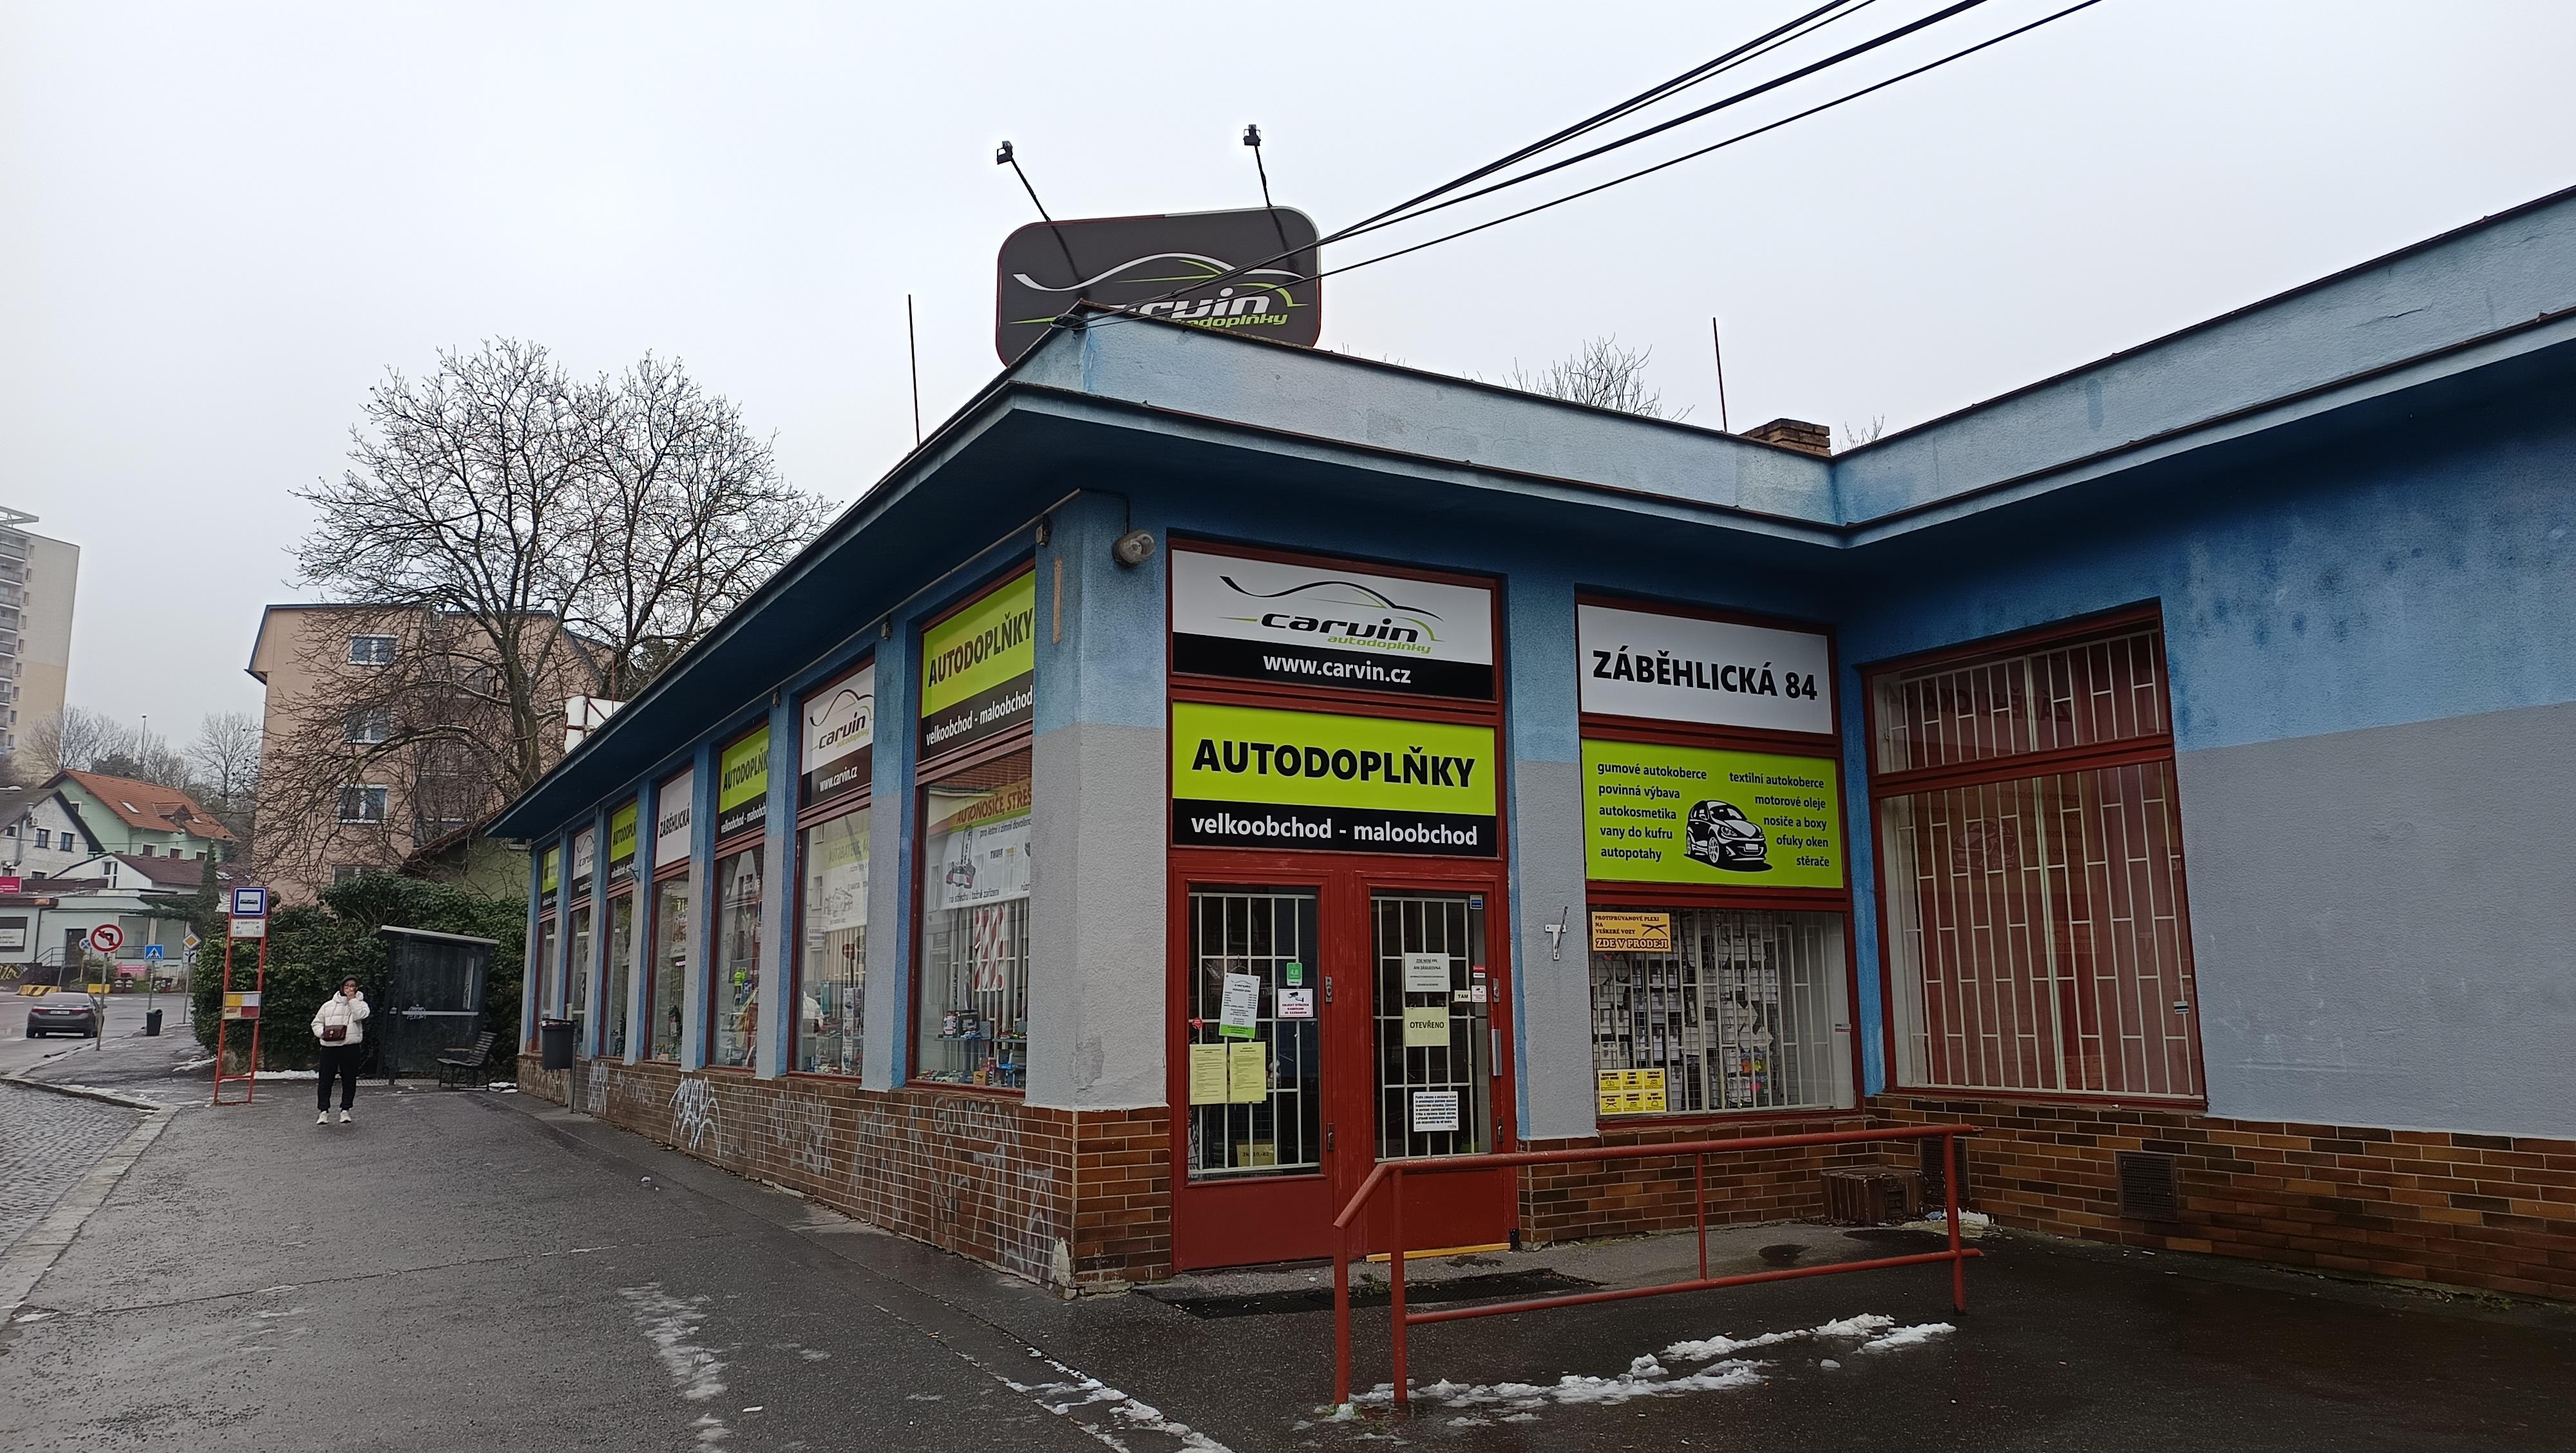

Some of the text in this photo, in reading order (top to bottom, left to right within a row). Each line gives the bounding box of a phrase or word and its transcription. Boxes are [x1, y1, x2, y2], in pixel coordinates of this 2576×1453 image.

[1261, 613, 1418, 643] carvin
[928, 608, 1033, 687] AUTODOPLŇKY
[1327, 634, 1432, 654] autodoplňky
[1264, 655, 1411, 683] www.carvin.cz
[1593, 645, 1817, 700] ZÁBĚHLICKÁ 84
[926, 710, 973, 746] velkoobchod
[980, 685, 1033, 725] maloobchod
[819, 712, 866, 749] carvin
[723, 747, 768, 793] AUTODOPLŇK
[1191, 739, 1475, 788] AUTODOPLŇKY
[1597, 763, 1707, 780] gumové autokoberce
[820, 766, 858, 792] www.carvin.cz
[1729, 772, 1824, 788] textilní autokoberce
[1007, 784, 1031, 811] STŘEŠ
[1598, 784, 1680, 800] povinná výbava
[747, 802, 766, 822] maloobch
[1599, 805, 1676, 820] autokosmetika
[1755, 795, 1826, 811] motorové oleje
[659, 802, 690, 838] ZÁBĚHLICKÁ
[1191, 813, 1332, 839] velkoobchod
[1354, 821, 1477, 846] maloobchod
[1763, 816, 1794, 826] nosiče
[1804, 818, 1827, 831] boxy
[612, 816, 636, 847] AUTODOPLŇ
[1600, 826, 1672, 839] vany do kufru
[1776, 835, 1828, 848] ofuky oken
[1600, 847, 1662, 862] autopotahy
[1796, 855, 1830, 867] stěrače
[1596, 938, 1669, 948] ZDE V PRODEJI
[1410, 1020, 1444, 1029] OTEVŘENO
